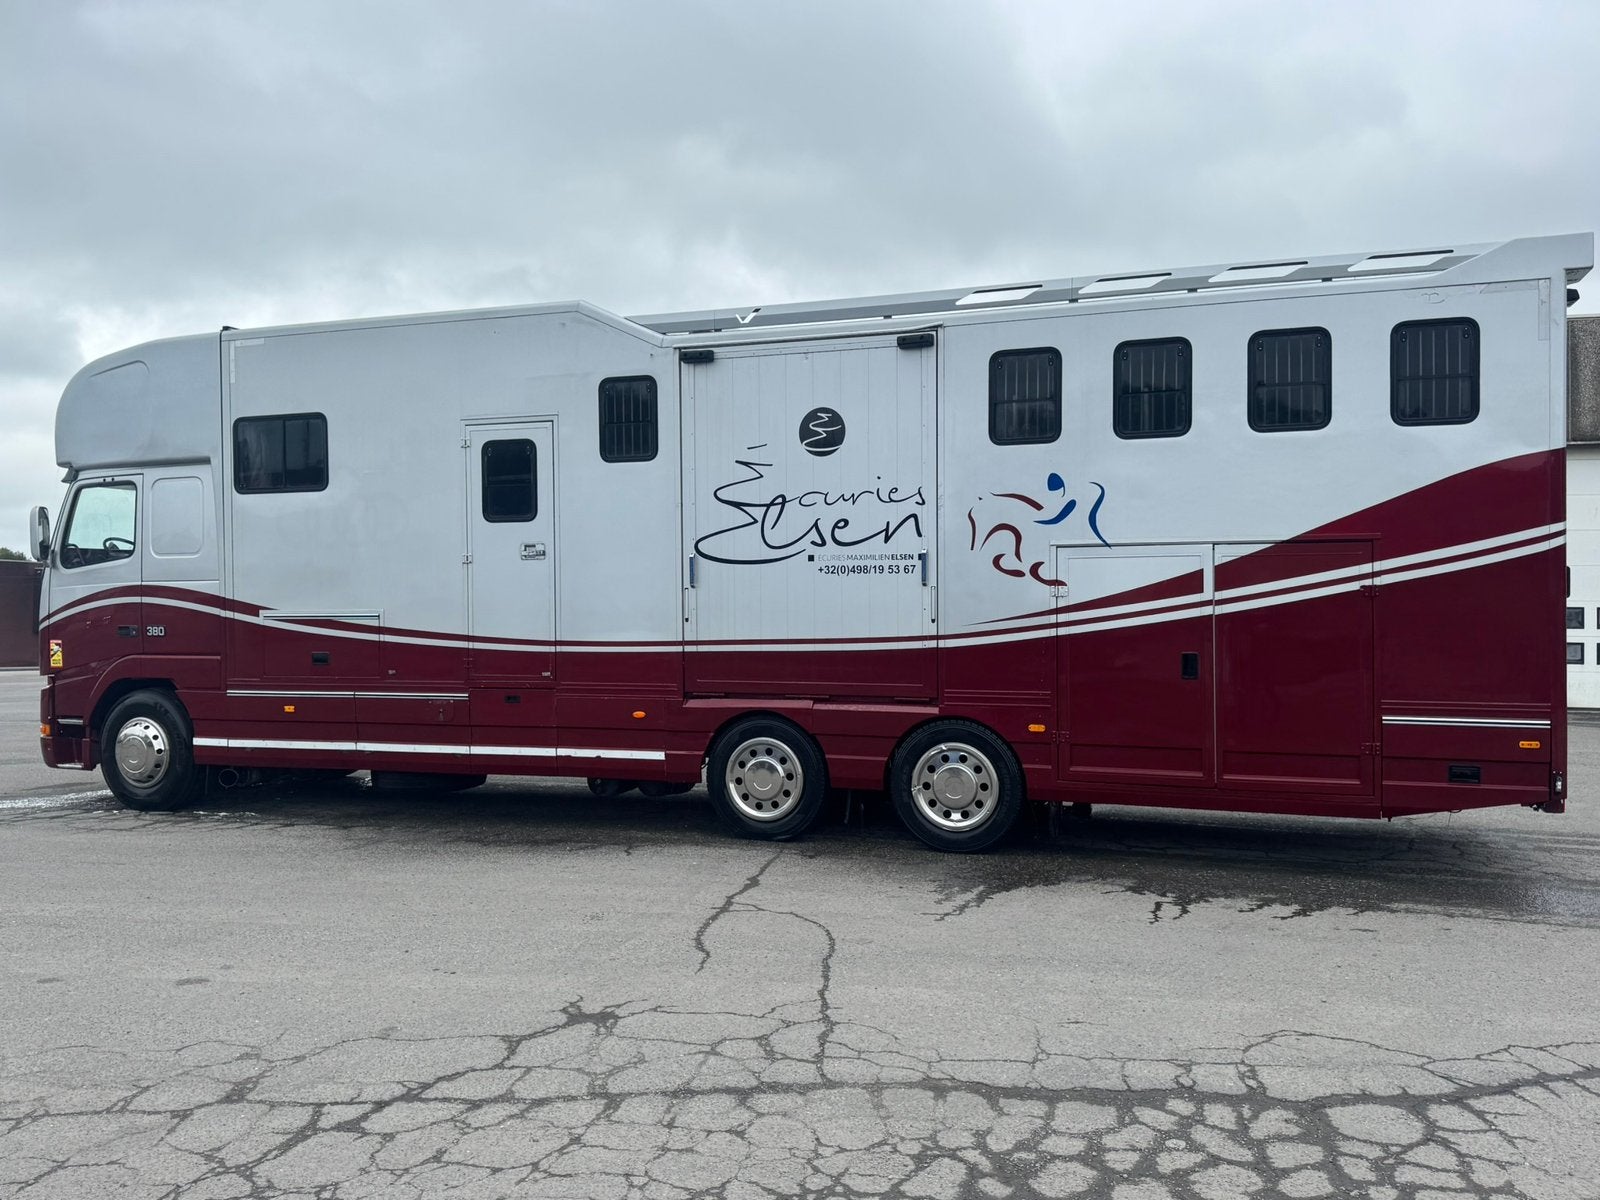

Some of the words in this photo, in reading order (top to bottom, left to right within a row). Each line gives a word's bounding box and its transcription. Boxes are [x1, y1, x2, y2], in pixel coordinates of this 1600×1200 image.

[817, 564, 885, 577] +32(0)498/19
[888, 565, 901, 575] 53
[903, 564, 917, 575] 67
[146, 626, 165, 636] 380
